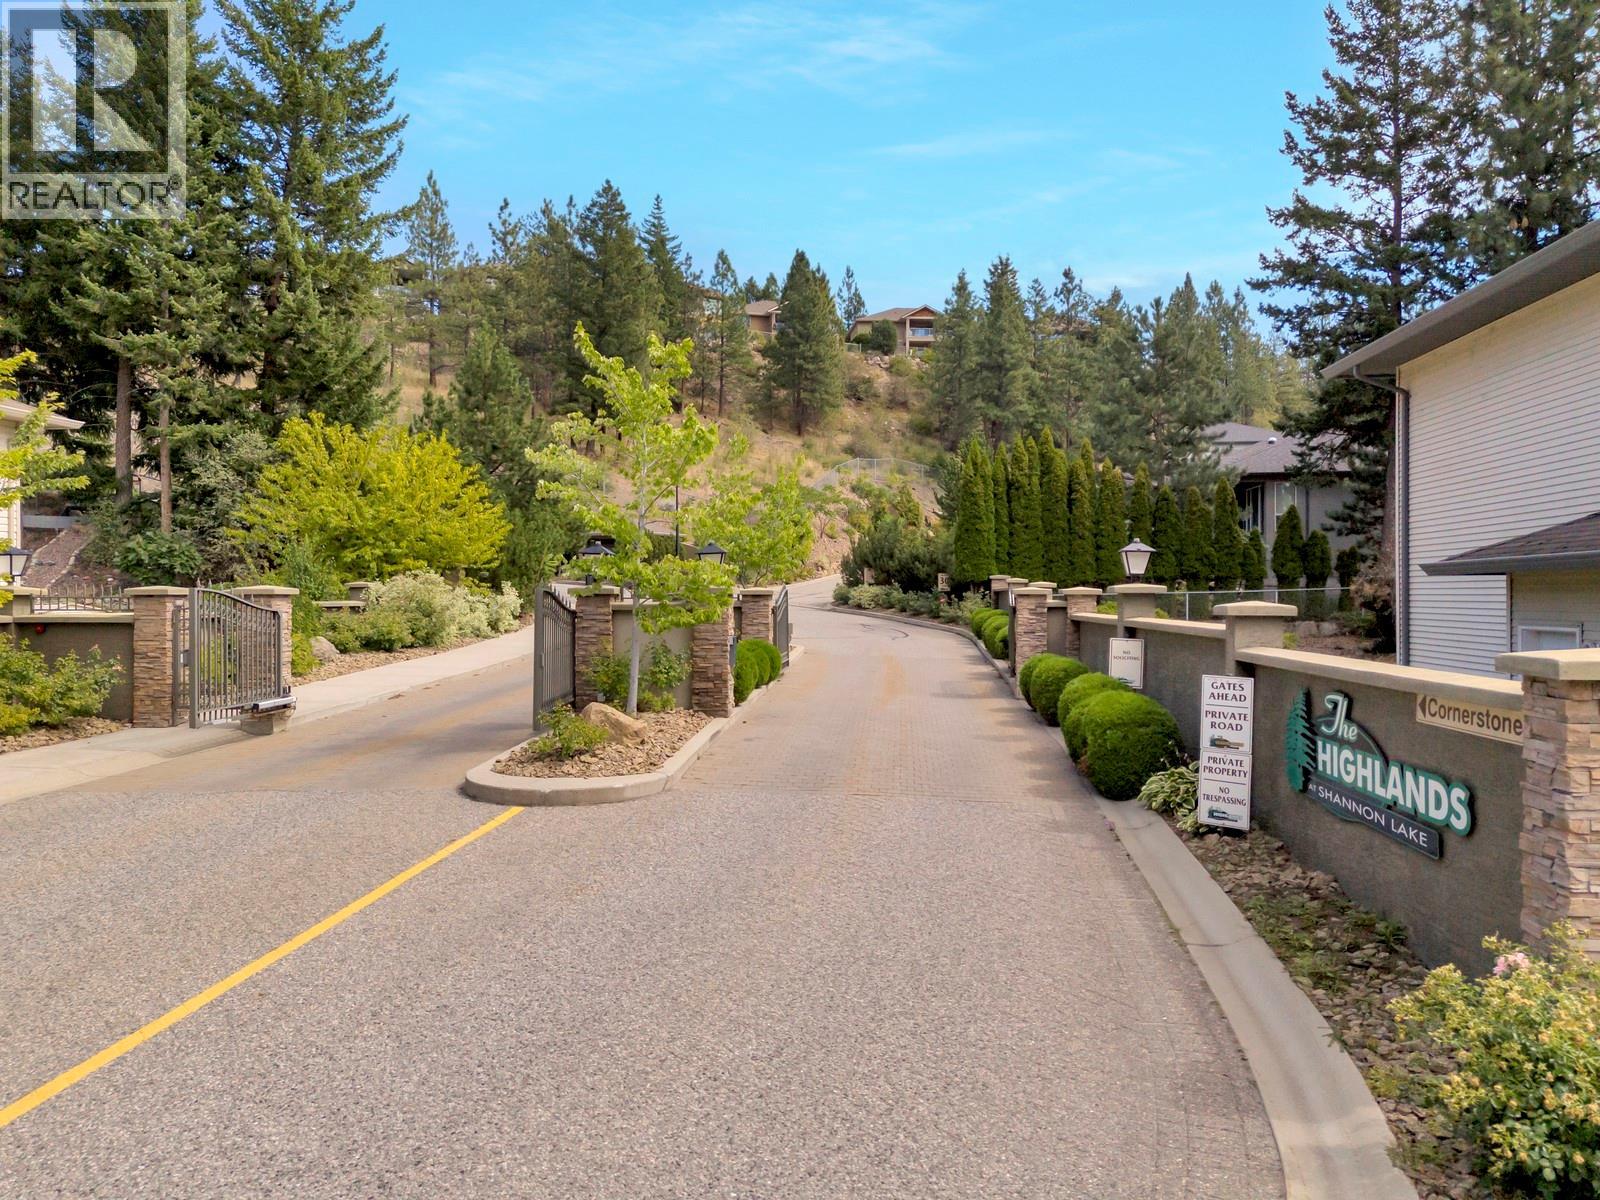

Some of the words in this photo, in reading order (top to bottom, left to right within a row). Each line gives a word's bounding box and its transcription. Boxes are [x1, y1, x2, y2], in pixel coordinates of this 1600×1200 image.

[1211, 681, 1245, 691] GATES
[1208, 692, 1247, 702] AHEAD
[1205, 710, 1249, 721] PRIVATE
[1321, 693, 1358, 741] The
[1428, 698, 1523, 736] Cornerstone
[1210, 721, 1243, 731] ROAD
[1207, 756, 1245, 767] PRIVATE
[1203, 765, 1248, 778] PROPERTY
[1316, 739, 1468, 831] HIGHLANDS
[1202, 793, 1247, 806] TRESPASSING
[1308, 783, 1317, 792] AT
[1318, 785, 1385, 827] SHANNON
[1391, 818, 1428, 847] LAKE
